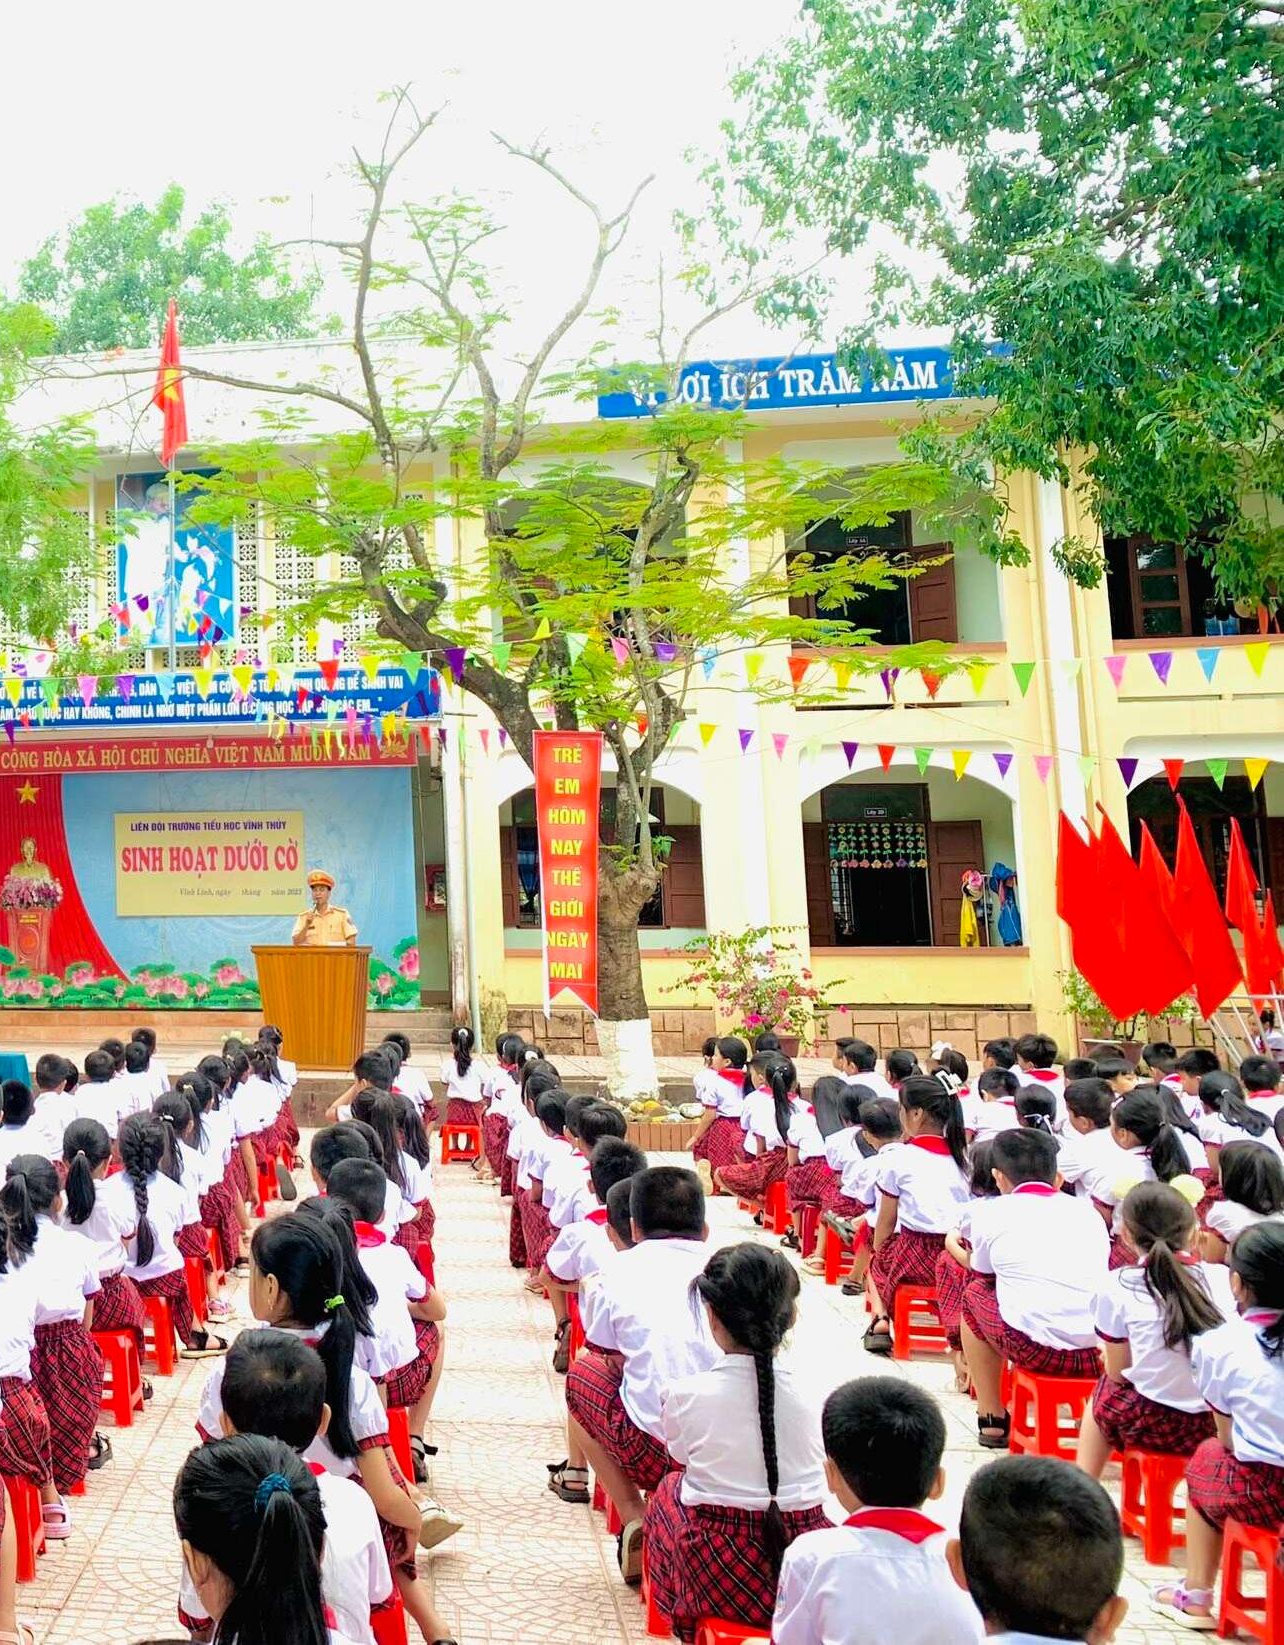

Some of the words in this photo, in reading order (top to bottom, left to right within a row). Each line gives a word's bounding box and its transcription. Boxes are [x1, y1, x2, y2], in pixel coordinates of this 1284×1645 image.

[675, 371, 711, 404] ỢI
[778, 360, 861, 398] TRĂM
[139, 680, 157, 697] DÂN
[176, 679, 195, 698] VIỆT
[347, 670, 360, 690] ĐỂ
[388, 675, 404, 689] VAI
[63, 706, 80, 721] HAY
[81, 703, 113, 721] KHÔNG,
[143, 701, 155, 718] LÀ
[156, 700, 175, 717] NHỜ
[176, 701, 195, 719] MỘT
[276, 700, 294, 717] HỌC
[1, 748, 39, 771] CỘNG
[43, 746, 73, 769] HÒA
[76, 746, 96, 767] XÃ
[100, 745, 126, 770] HỘI
[131, 742, 159, 765] CHỦ
[165, 743, 211, 765] NGHĨA
[215, 742, 249, 766] VIỆT
[253, 745, 285, 763] NAM
[552, 743, 582, 764] TRẺ
[554, 778, 580, 794] EM
[548, 805, 586, 825] HÔM
[130, 820, 149, 832] LIÊN
[151, 820, 165, 834] ĐỘI
[168, 819, 201, 832] TRƯỜNG
[204, 818, 221, 831] TIỂU
[223, 820, 241, 832] HỌC
[243, 818, 263, 831] VĨNH
[550, 838, 582, 856] NAY
[121, 846, 164, 873] SINH
[169, 846, 219, 879] HOẠT
[223, 838, 269, 872] DƯỚI
[274, 837, 299, 872] CỜ
[552, 866, 582, 887] THẾ
[549, 897, 584, 918] GIỚI
[546, 928, 588, 949] NGÀY
[550, 961, 583, 979] MAI
